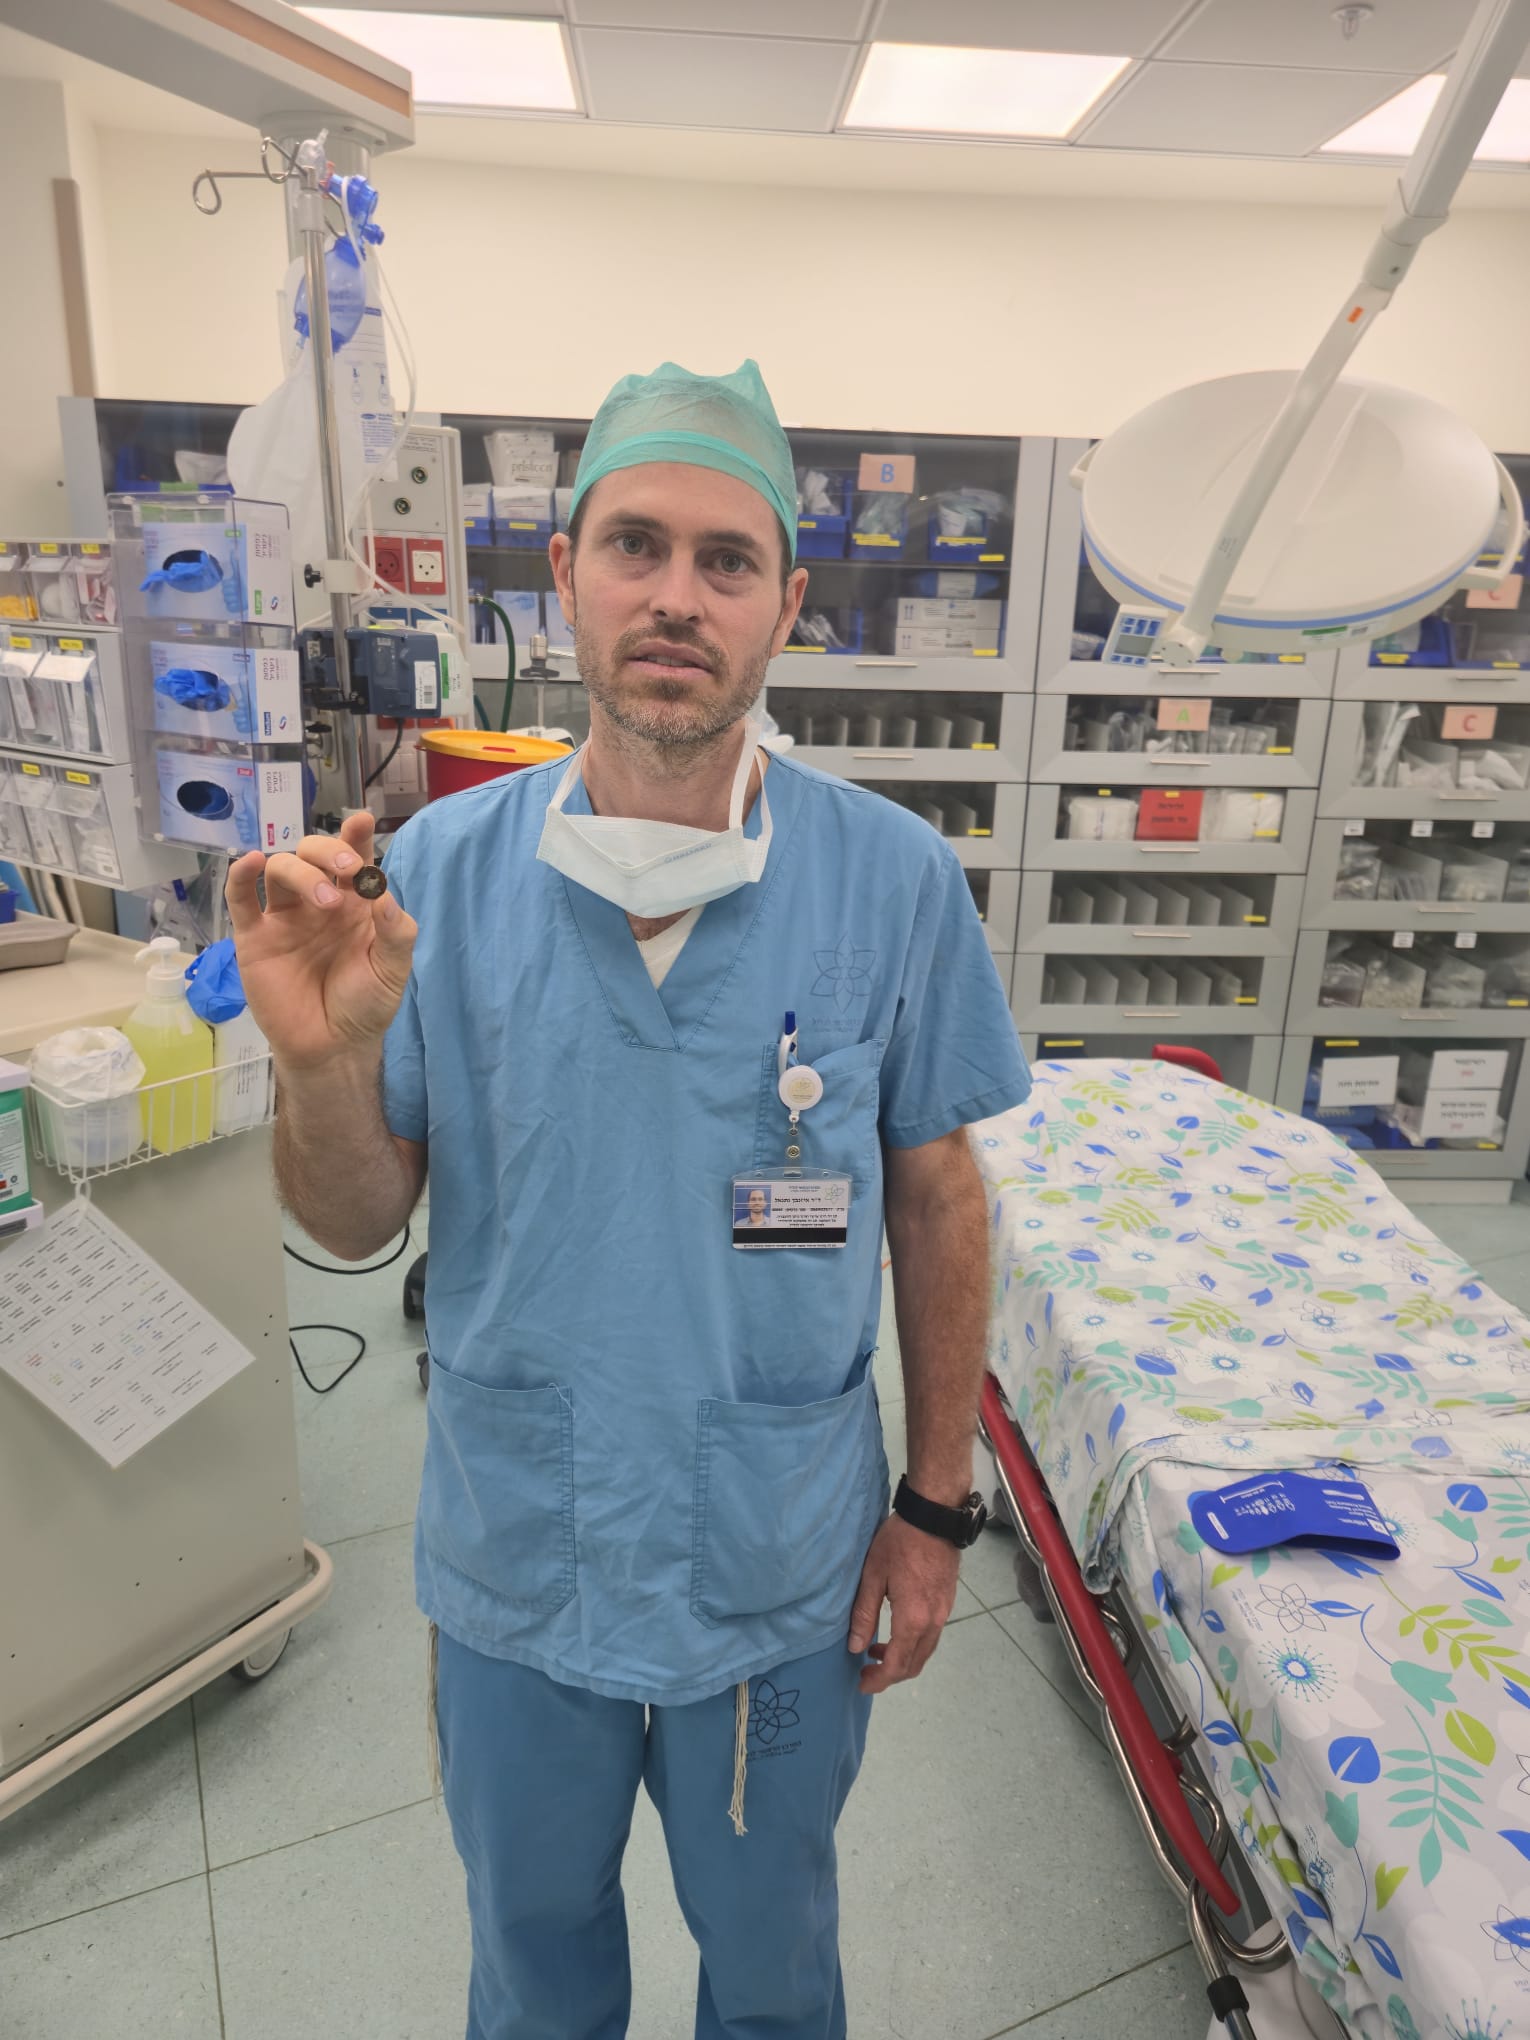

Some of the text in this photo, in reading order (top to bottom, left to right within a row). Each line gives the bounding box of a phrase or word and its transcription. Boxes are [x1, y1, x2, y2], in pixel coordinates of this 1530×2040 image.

[881, 463, 895, 483] B
[1176, 707, 1190, 722] A
[1463, 714, 1479, 732] C
